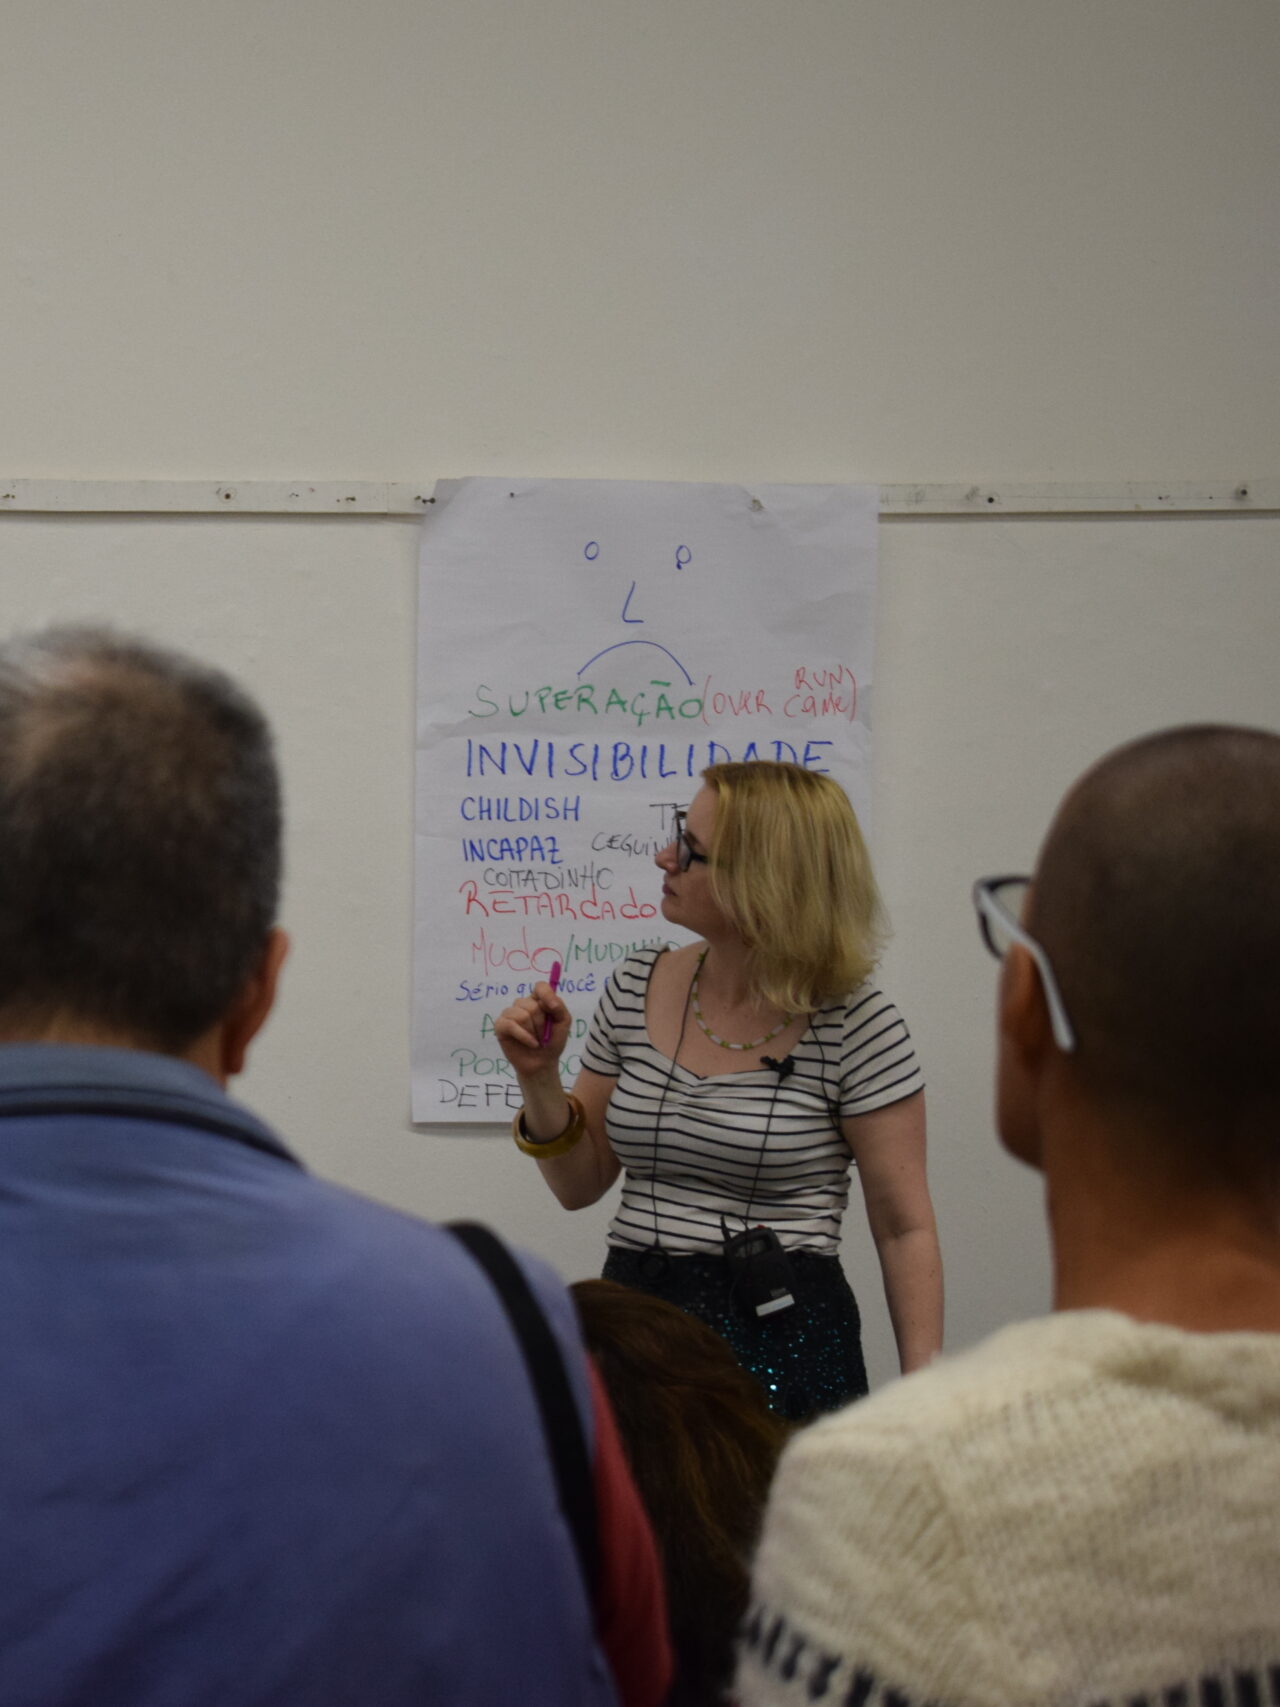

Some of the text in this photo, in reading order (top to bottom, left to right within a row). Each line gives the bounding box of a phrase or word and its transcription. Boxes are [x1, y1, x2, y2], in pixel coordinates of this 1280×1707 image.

[460, 795, 581, 823] CHILDISH
[462, 834, 564, 865] INCAPAZ
[455, 979, 509, 1002] Sério
[516, 982, 536, 999] qu
